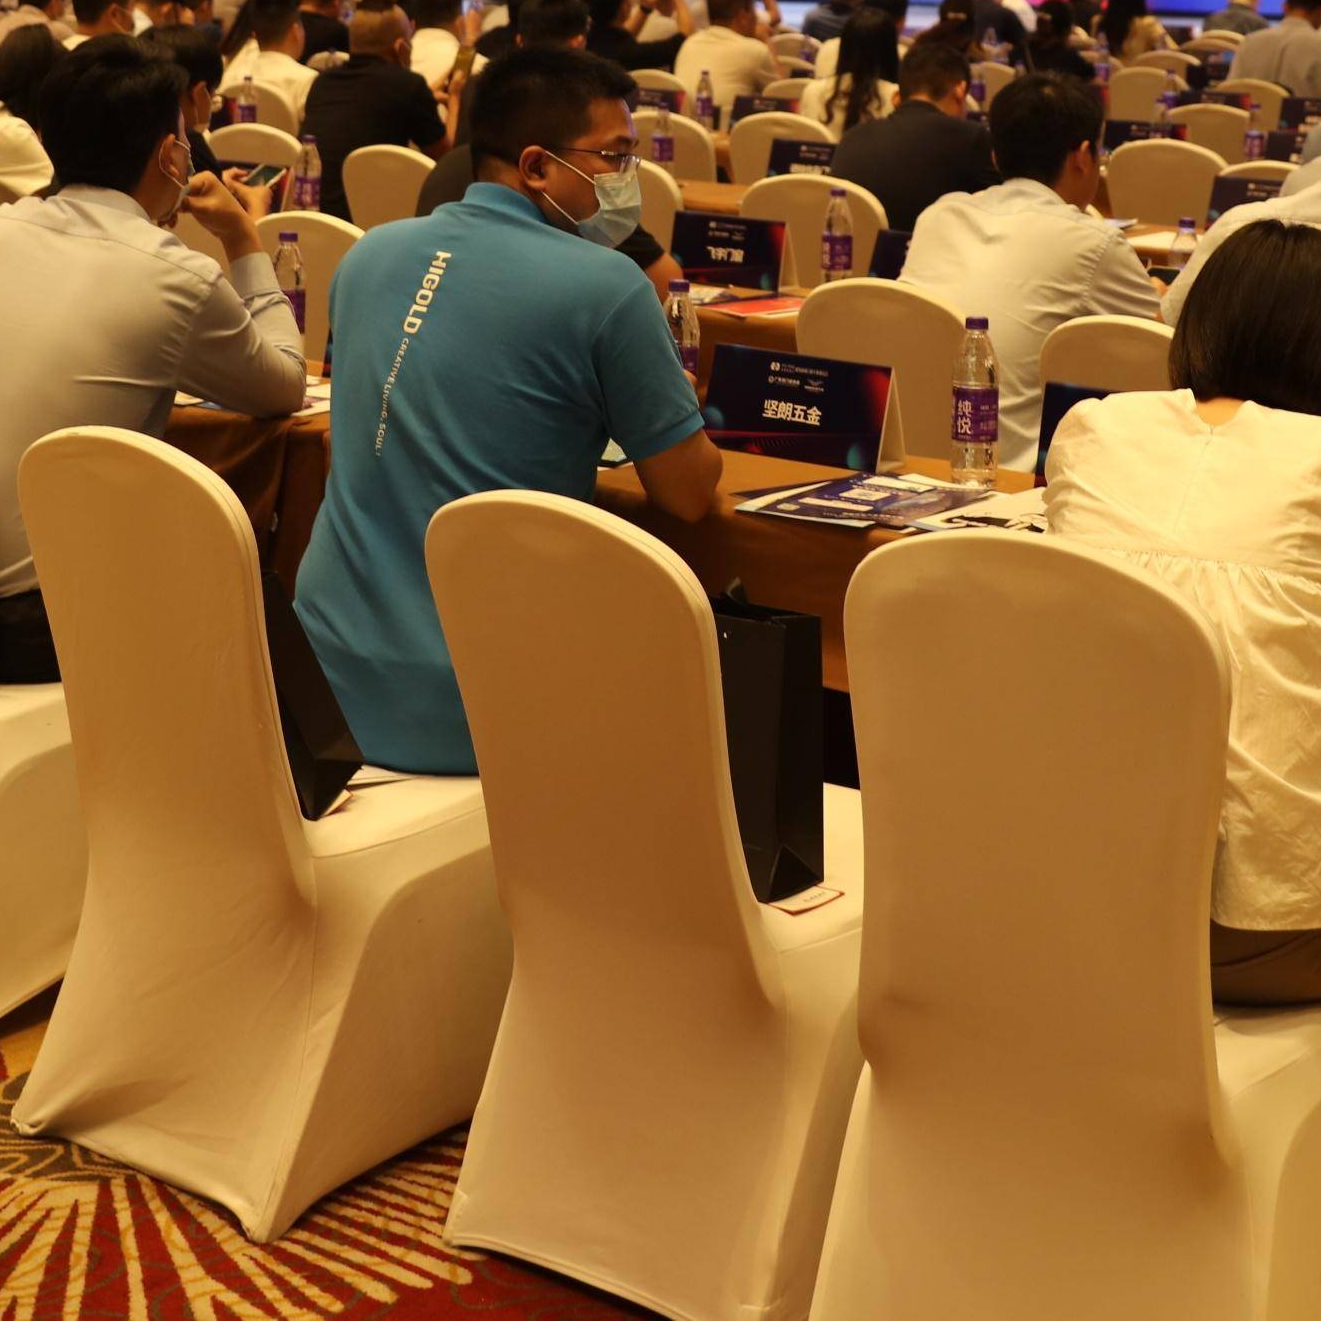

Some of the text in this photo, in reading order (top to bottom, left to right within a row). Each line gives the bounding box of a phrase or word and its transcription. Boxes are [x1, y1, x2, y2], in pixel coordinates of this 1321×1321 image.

[403, 250, 452, 334] HIGOLD
[387, 337, 409, 384] CREATIVE
[762, 399, 822, 426] 坚朗五金
[958, 399, 973, 435] 纯悦
